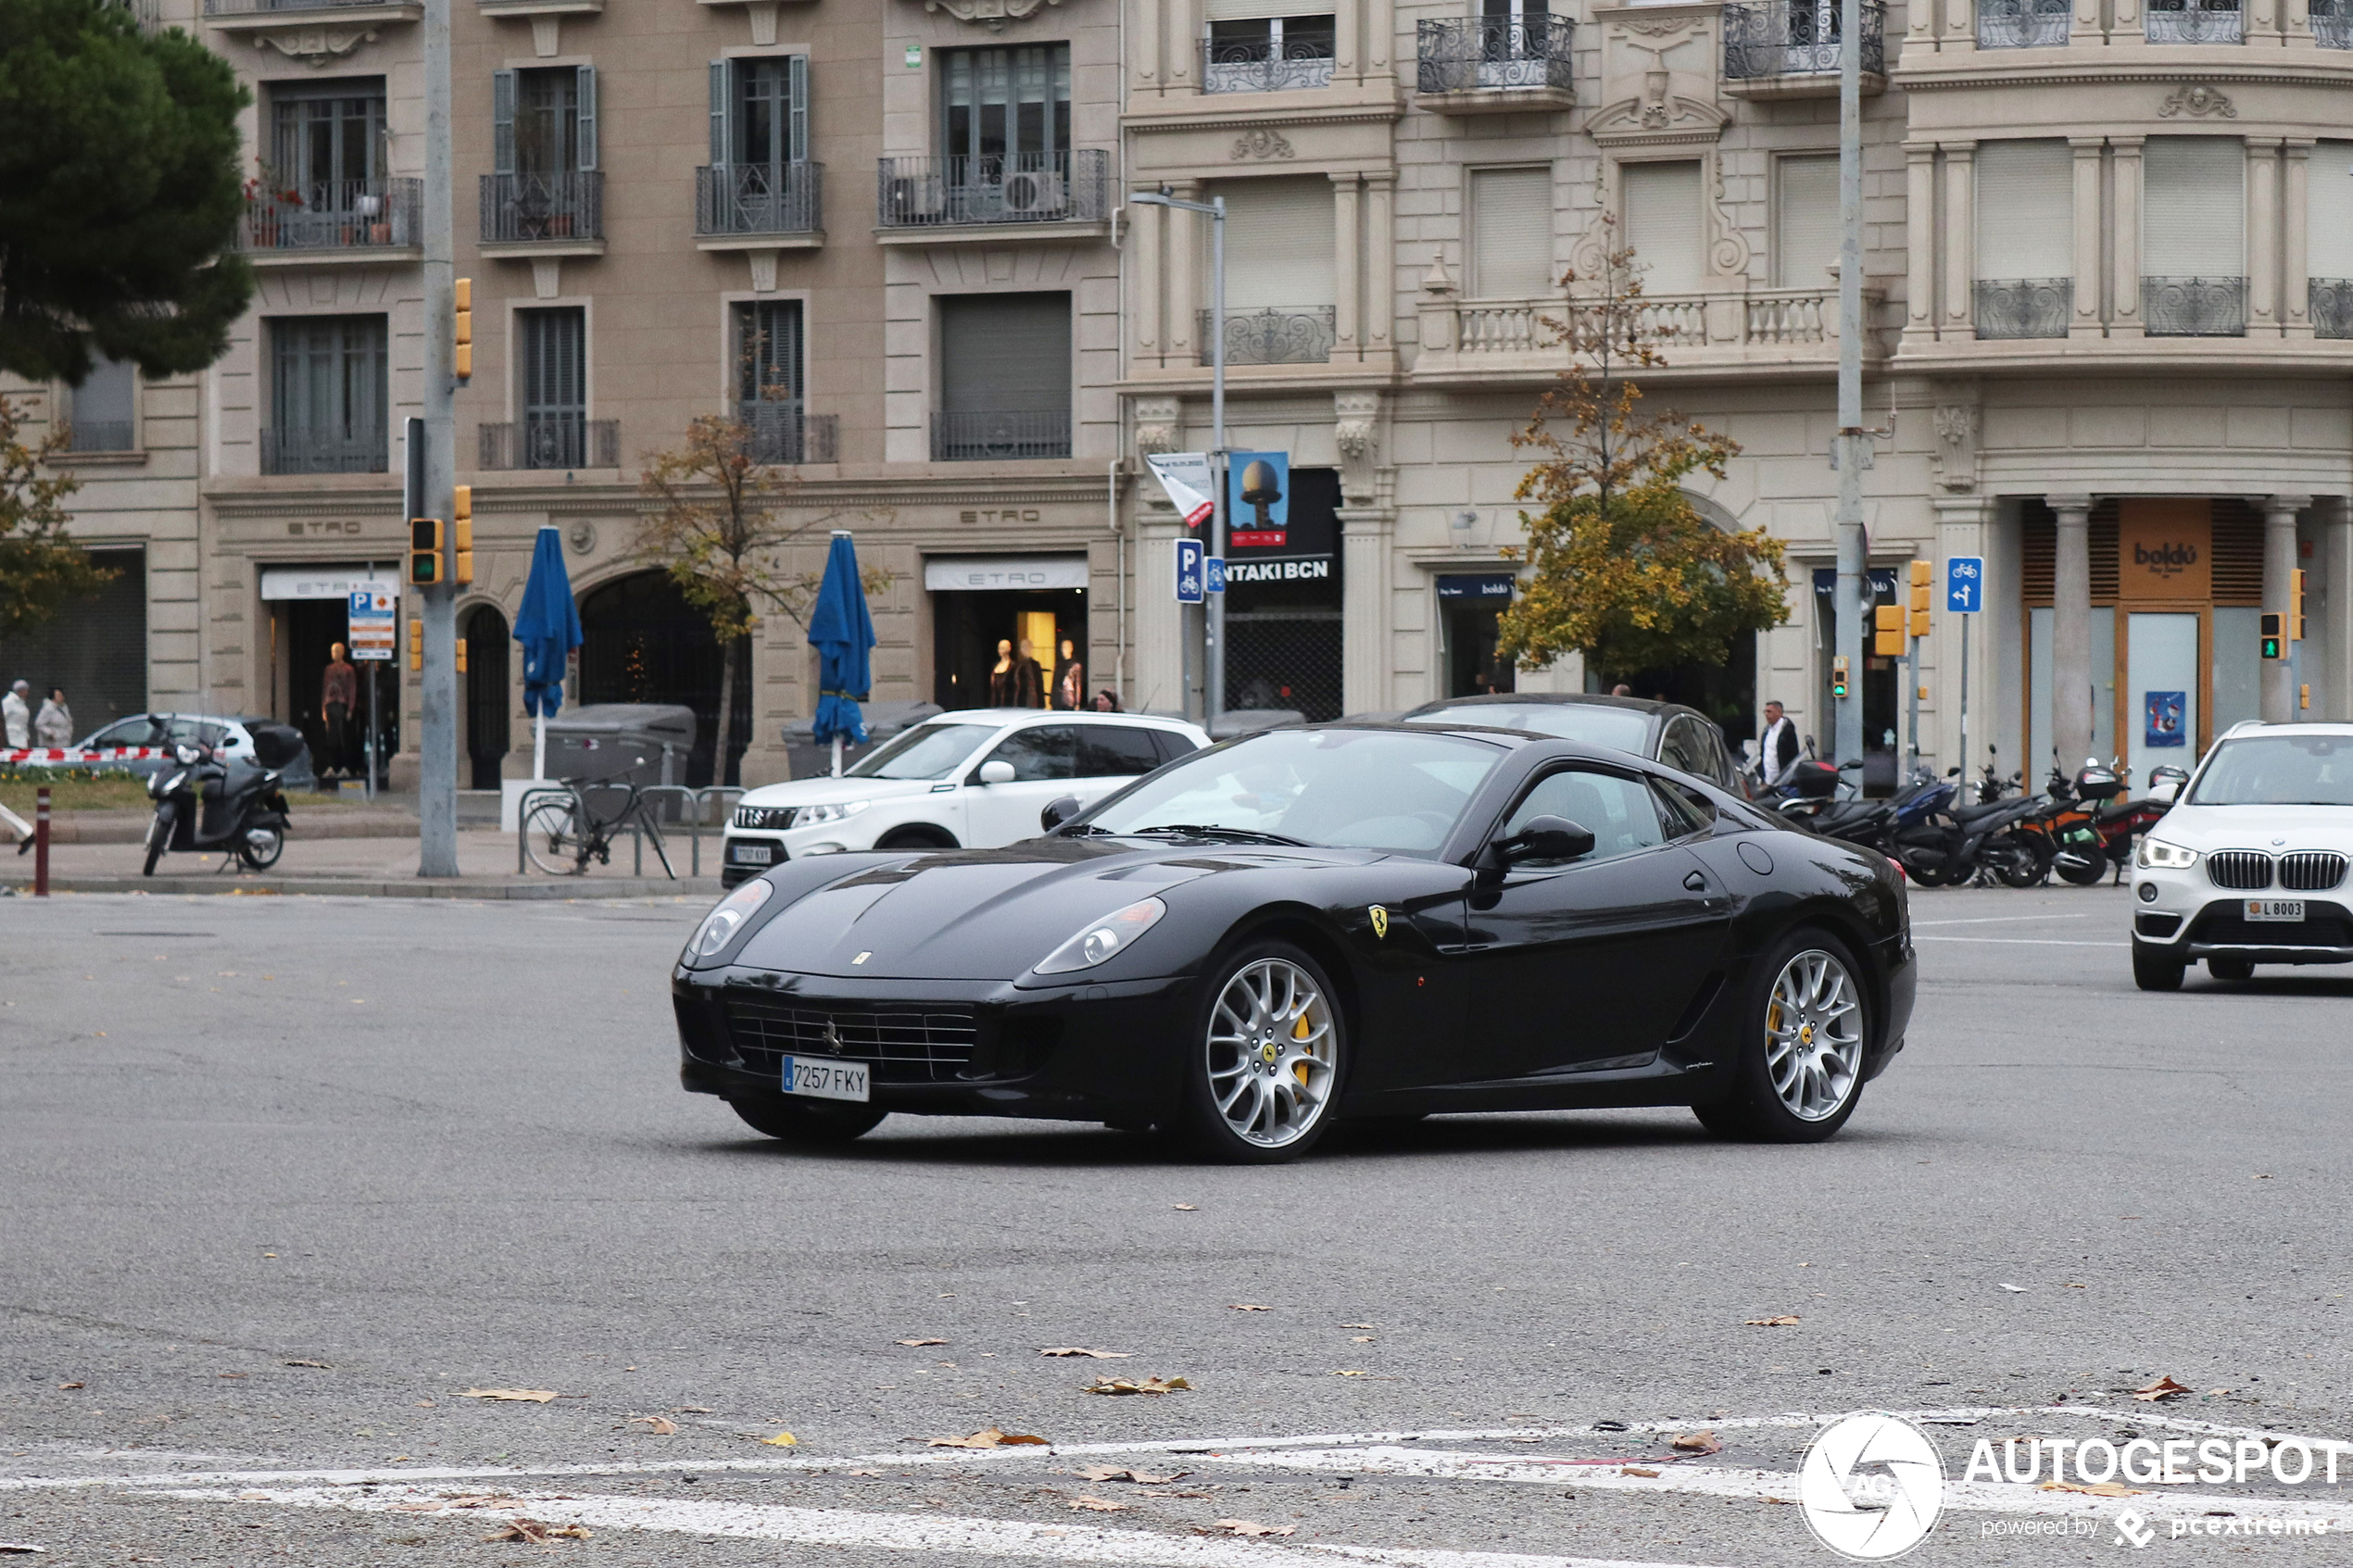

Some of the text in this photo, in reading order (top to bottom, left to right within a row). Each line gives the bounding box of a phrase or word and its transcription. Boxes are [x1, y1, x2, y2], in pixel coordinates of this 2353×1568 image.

[961, 509, 1039, 523] ETRO
[288, 521, 360, 534] ETRO
[1183, 548, 1196, 571] P
[2134, 543, 2196, 565] boldú
[1284, 560, 1328, 579] BCN
[969, 572, 1046, 584] ETRO
[296, 582, 348, 594] ETR
[354, 594, 368, 609] P
[2264, 902, 2302, 915] L 8003
[794, 1064, 865, 1093] 7257 FKY
